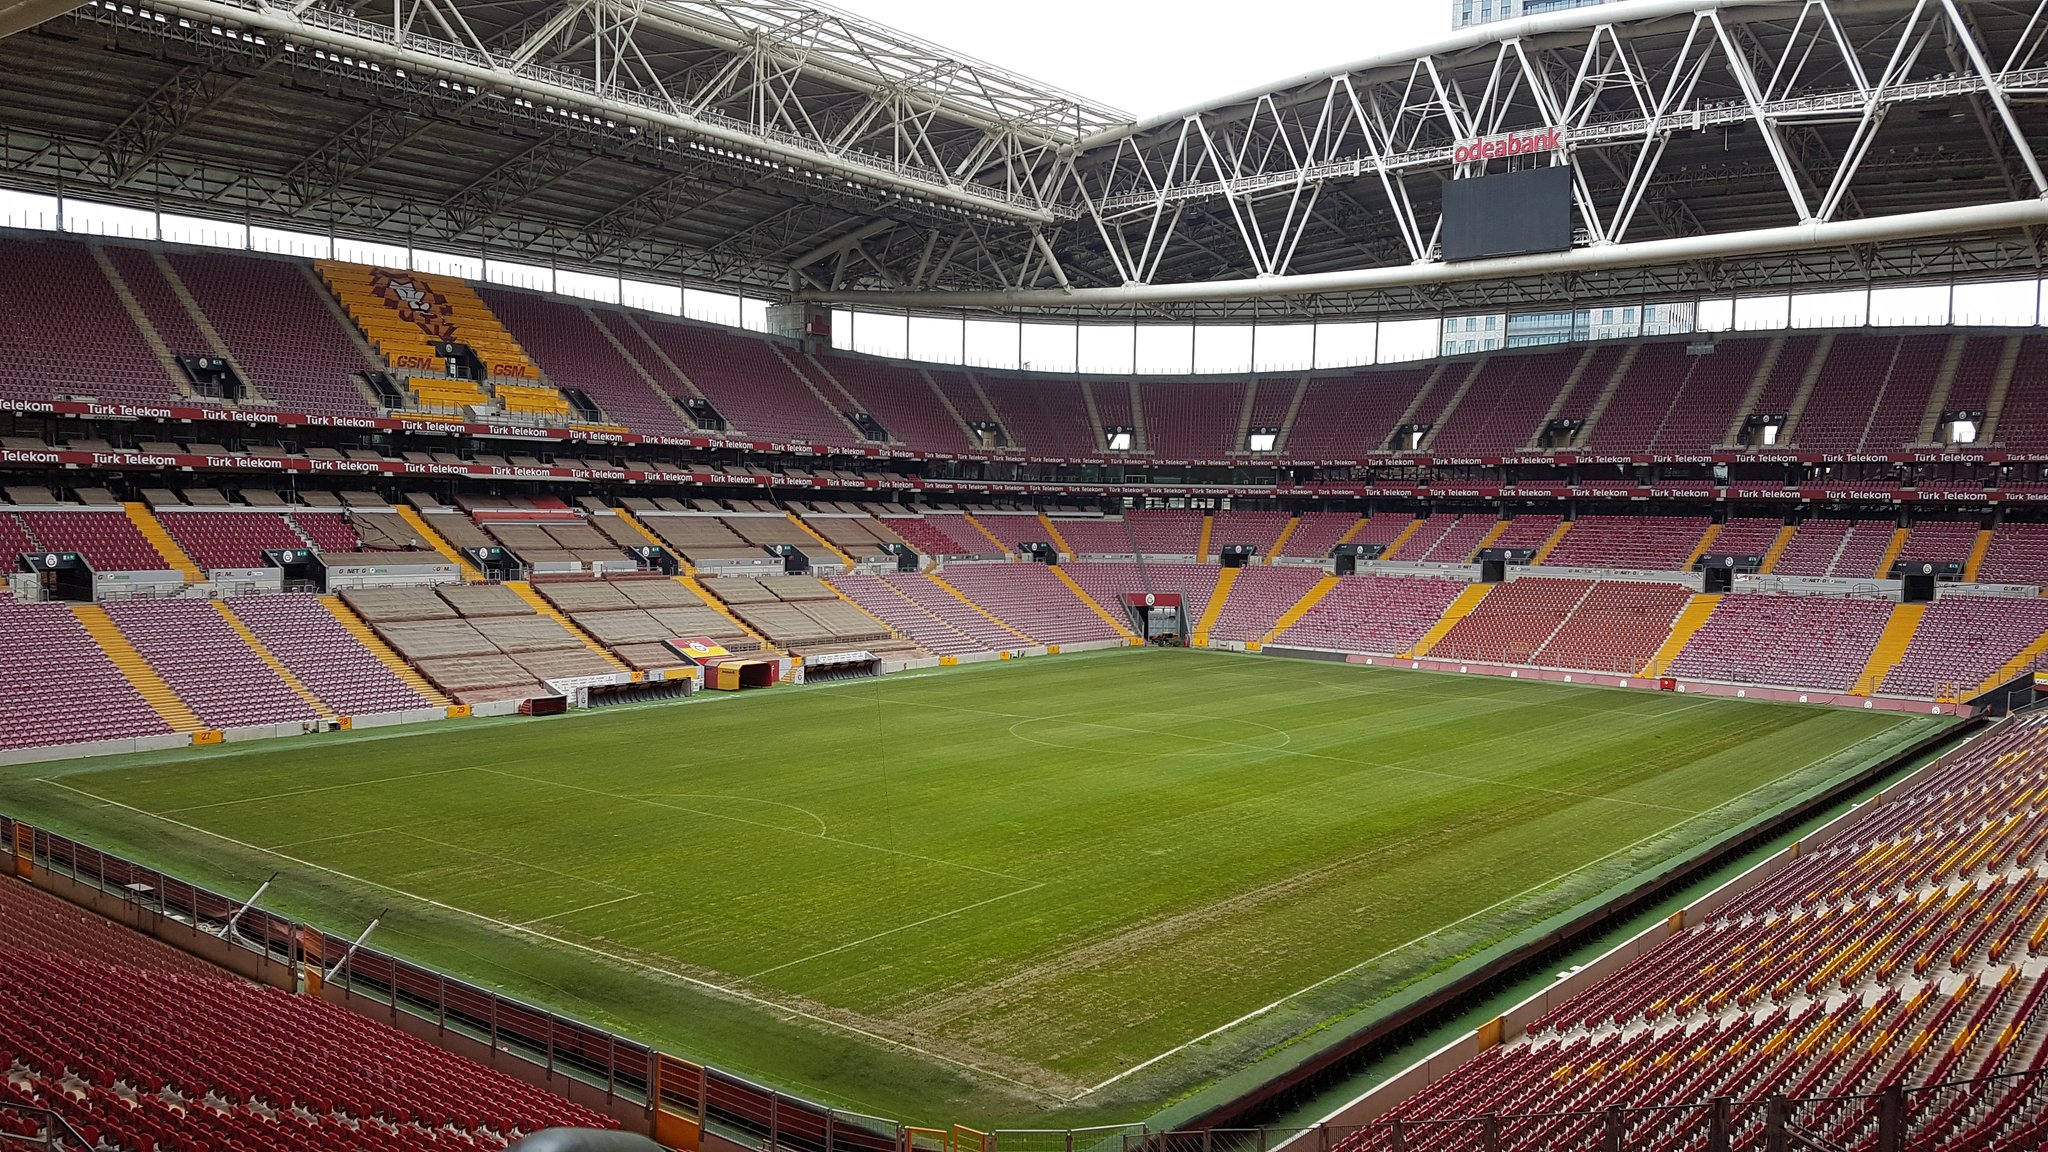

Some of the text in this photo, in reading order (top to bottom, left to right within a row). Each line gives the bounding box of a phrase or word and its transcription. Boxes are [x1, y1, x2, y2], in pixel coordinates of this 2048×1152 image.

[1454, 127, 1561, 162] odeabank
[397, 356, 433, 370] GSM
[494, 364, 526, 377] GSM
[88, 403, 170, 418] Türk Telekom
[202, 409, 277, 423] Türk Telekom
[306, 415, 374, 427] Türk Telekom
[401, 420, 464, 432] Türk Telekom
[489, 425, 547, 436] Türk Telekom
[569, 430, 622, 441] Türk Telekom
[642, 435, 690, 446] Türk Telekom
[709, 439, 753, 450] Türk Telekom
[772, 443, 812, 453] Türk Telekom
[2, 450, 58, 462] Telekom
[827, 446, 865, 456] Türk Telekom
[893, 450, 914, 458] Telekom
[93, 453, 175, 466] Türk Telekom
[206, 457, 281, 468] Türk Telekom
[1368, 458, 1414, 466] Türk Telekom
[1433, 457, 1481, 465] Türk Telekom
[1522, 456, 1553, 464] Telekom
[1575, 455, 1630, 464] Türk Telekom
[1653, 455, 1672, 463] Türk
[1736, 454, 1797, 463] Türk Telekom
[1822, 454, 1887, 462] Türk Telekom
[1914, 453, 1983, 462] Türk Telekom
[310, 460, 378, 472] Türk Telekom
[404, 463, 467, 474] Türk Telekom
[491, 466, 549, 476] Türk Telekom
[572, 469, 624, 479] Türk Telekom
[644, 472, 692, 482] Türk Telekom
[711, 474, 755, 484] Türk Telekom
[772, 477, 812, 486] Türk Telekom
[827, 478, 864, 487] Türk Telekom
[879, 480, 913, 489] Türk Telekom
[1366, 489, 1411, 497] Türk Telekom
[1430, 489, 1478, 497] Türk Telekom
[1499, 489, 1551, 497] Türk Telekom
[1572, 489, 1627, 497] Türk Telekom
[1651, 489, 1709, 497] Türk Telekom
[1739, 489, 1800, 499] Türk Telekom
[1825, 491, 1891, 499] Türk Telekom
[1918, 491, 1987, 501] Türk Telekom
[456, 706, 466, 714] 29
[201, 733, 211, 741] 27
